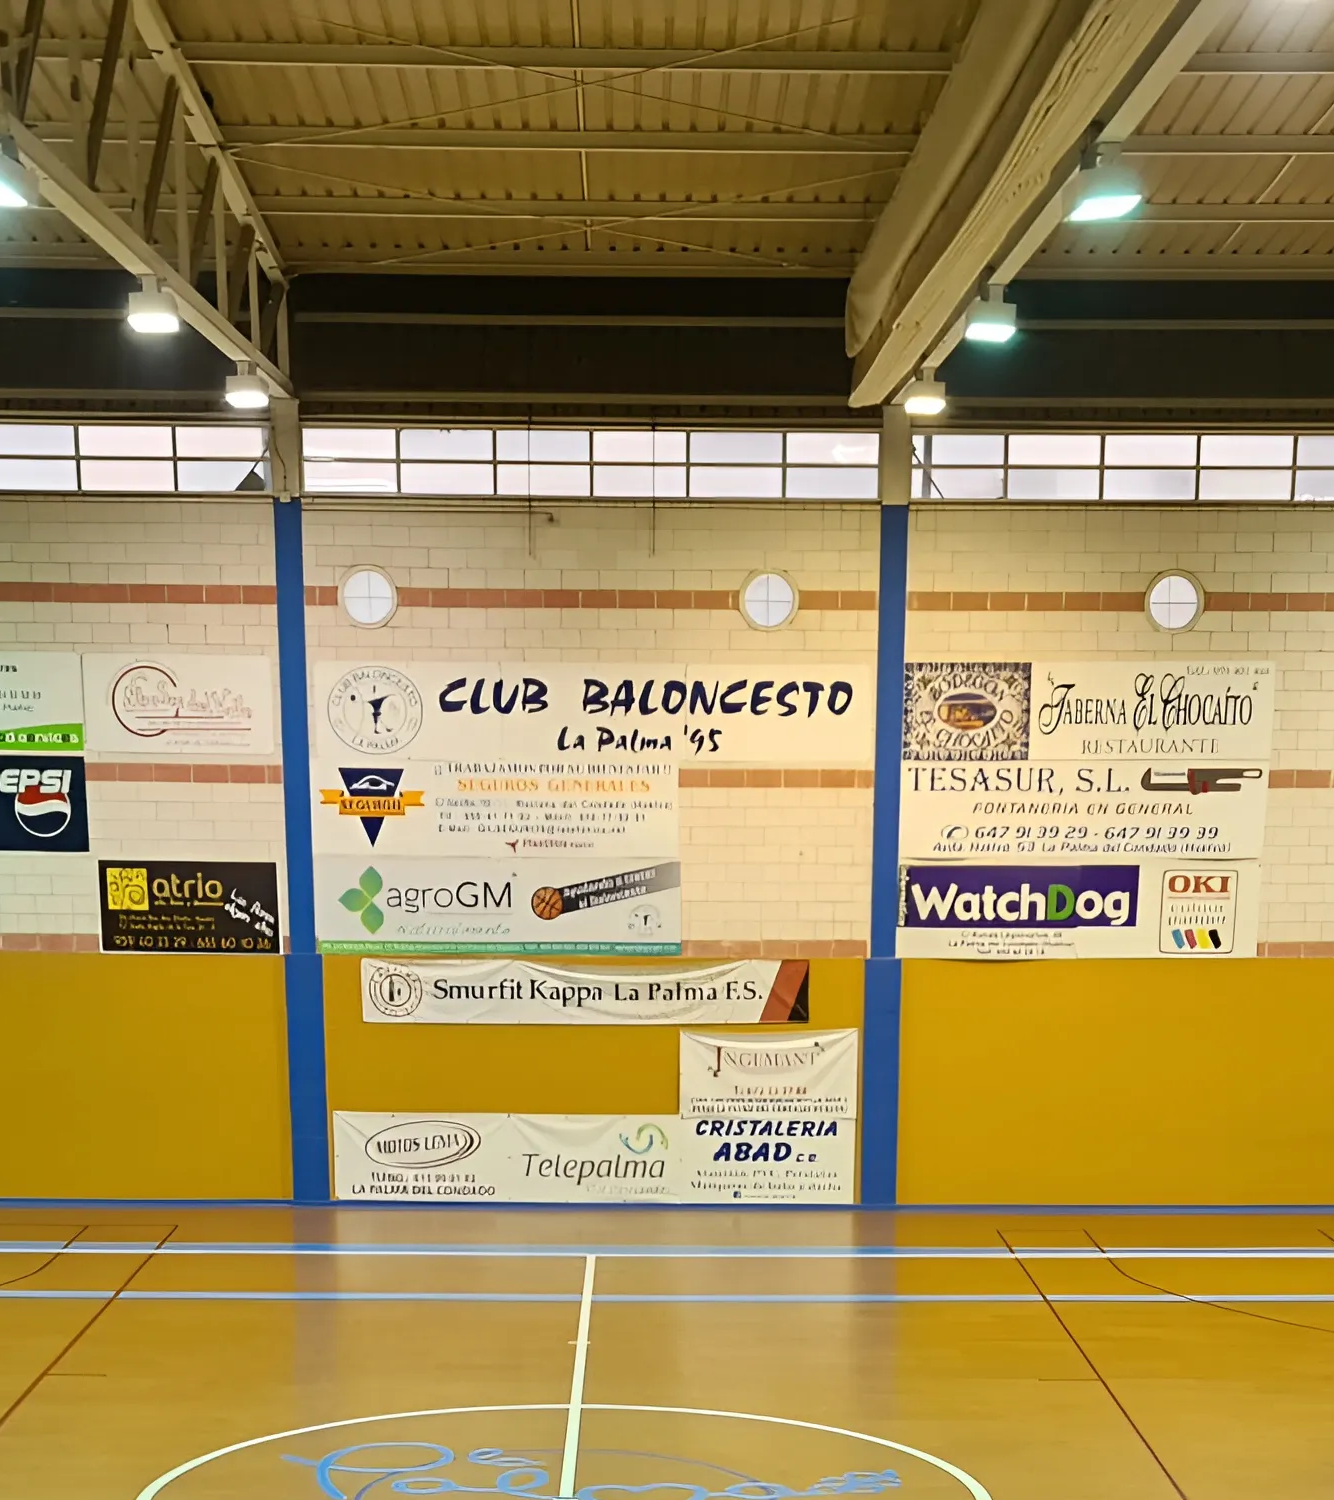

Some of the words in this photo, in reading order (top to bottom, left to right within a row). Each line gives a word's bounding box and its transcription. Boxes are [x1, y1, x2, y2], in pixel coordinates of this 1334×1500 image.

[438, 677, 549, 715] CLUB
[582, 679, 854, 717] BALONCESTO
[556, 726, 585, 751] La
[596, 726, 672, 755] Palma
[1082, 738, 1219, 754] RESTAURANTE
[907, 767, 1064, 796] TESASUR,
[1075, 768, 1130, 793] S.L.
[1115, 802, 1195, 816] GENERAL
[1104, 826, 1140, 840] 647
[152, 872, 224, 899] atrio
[386, 881, 512, 913] agroGM
[1168, 875, 1231, 893] OKI
[911, 882, 1131, 926] WatchDog
[434, 978, 523, 1000] Smurfit
[530, 978, 603, 1008] Kappa
[615, 983, 639, 1001] La
[648, 981, 717, 1001] Palma
[726, 980, 763, 1000] F.S.
[696, 1119, 838, 1138] CRISTALERIA
[713, 1142, 792, 1162] ABAD
[522, 1153, 665, 1186] Telepalma
